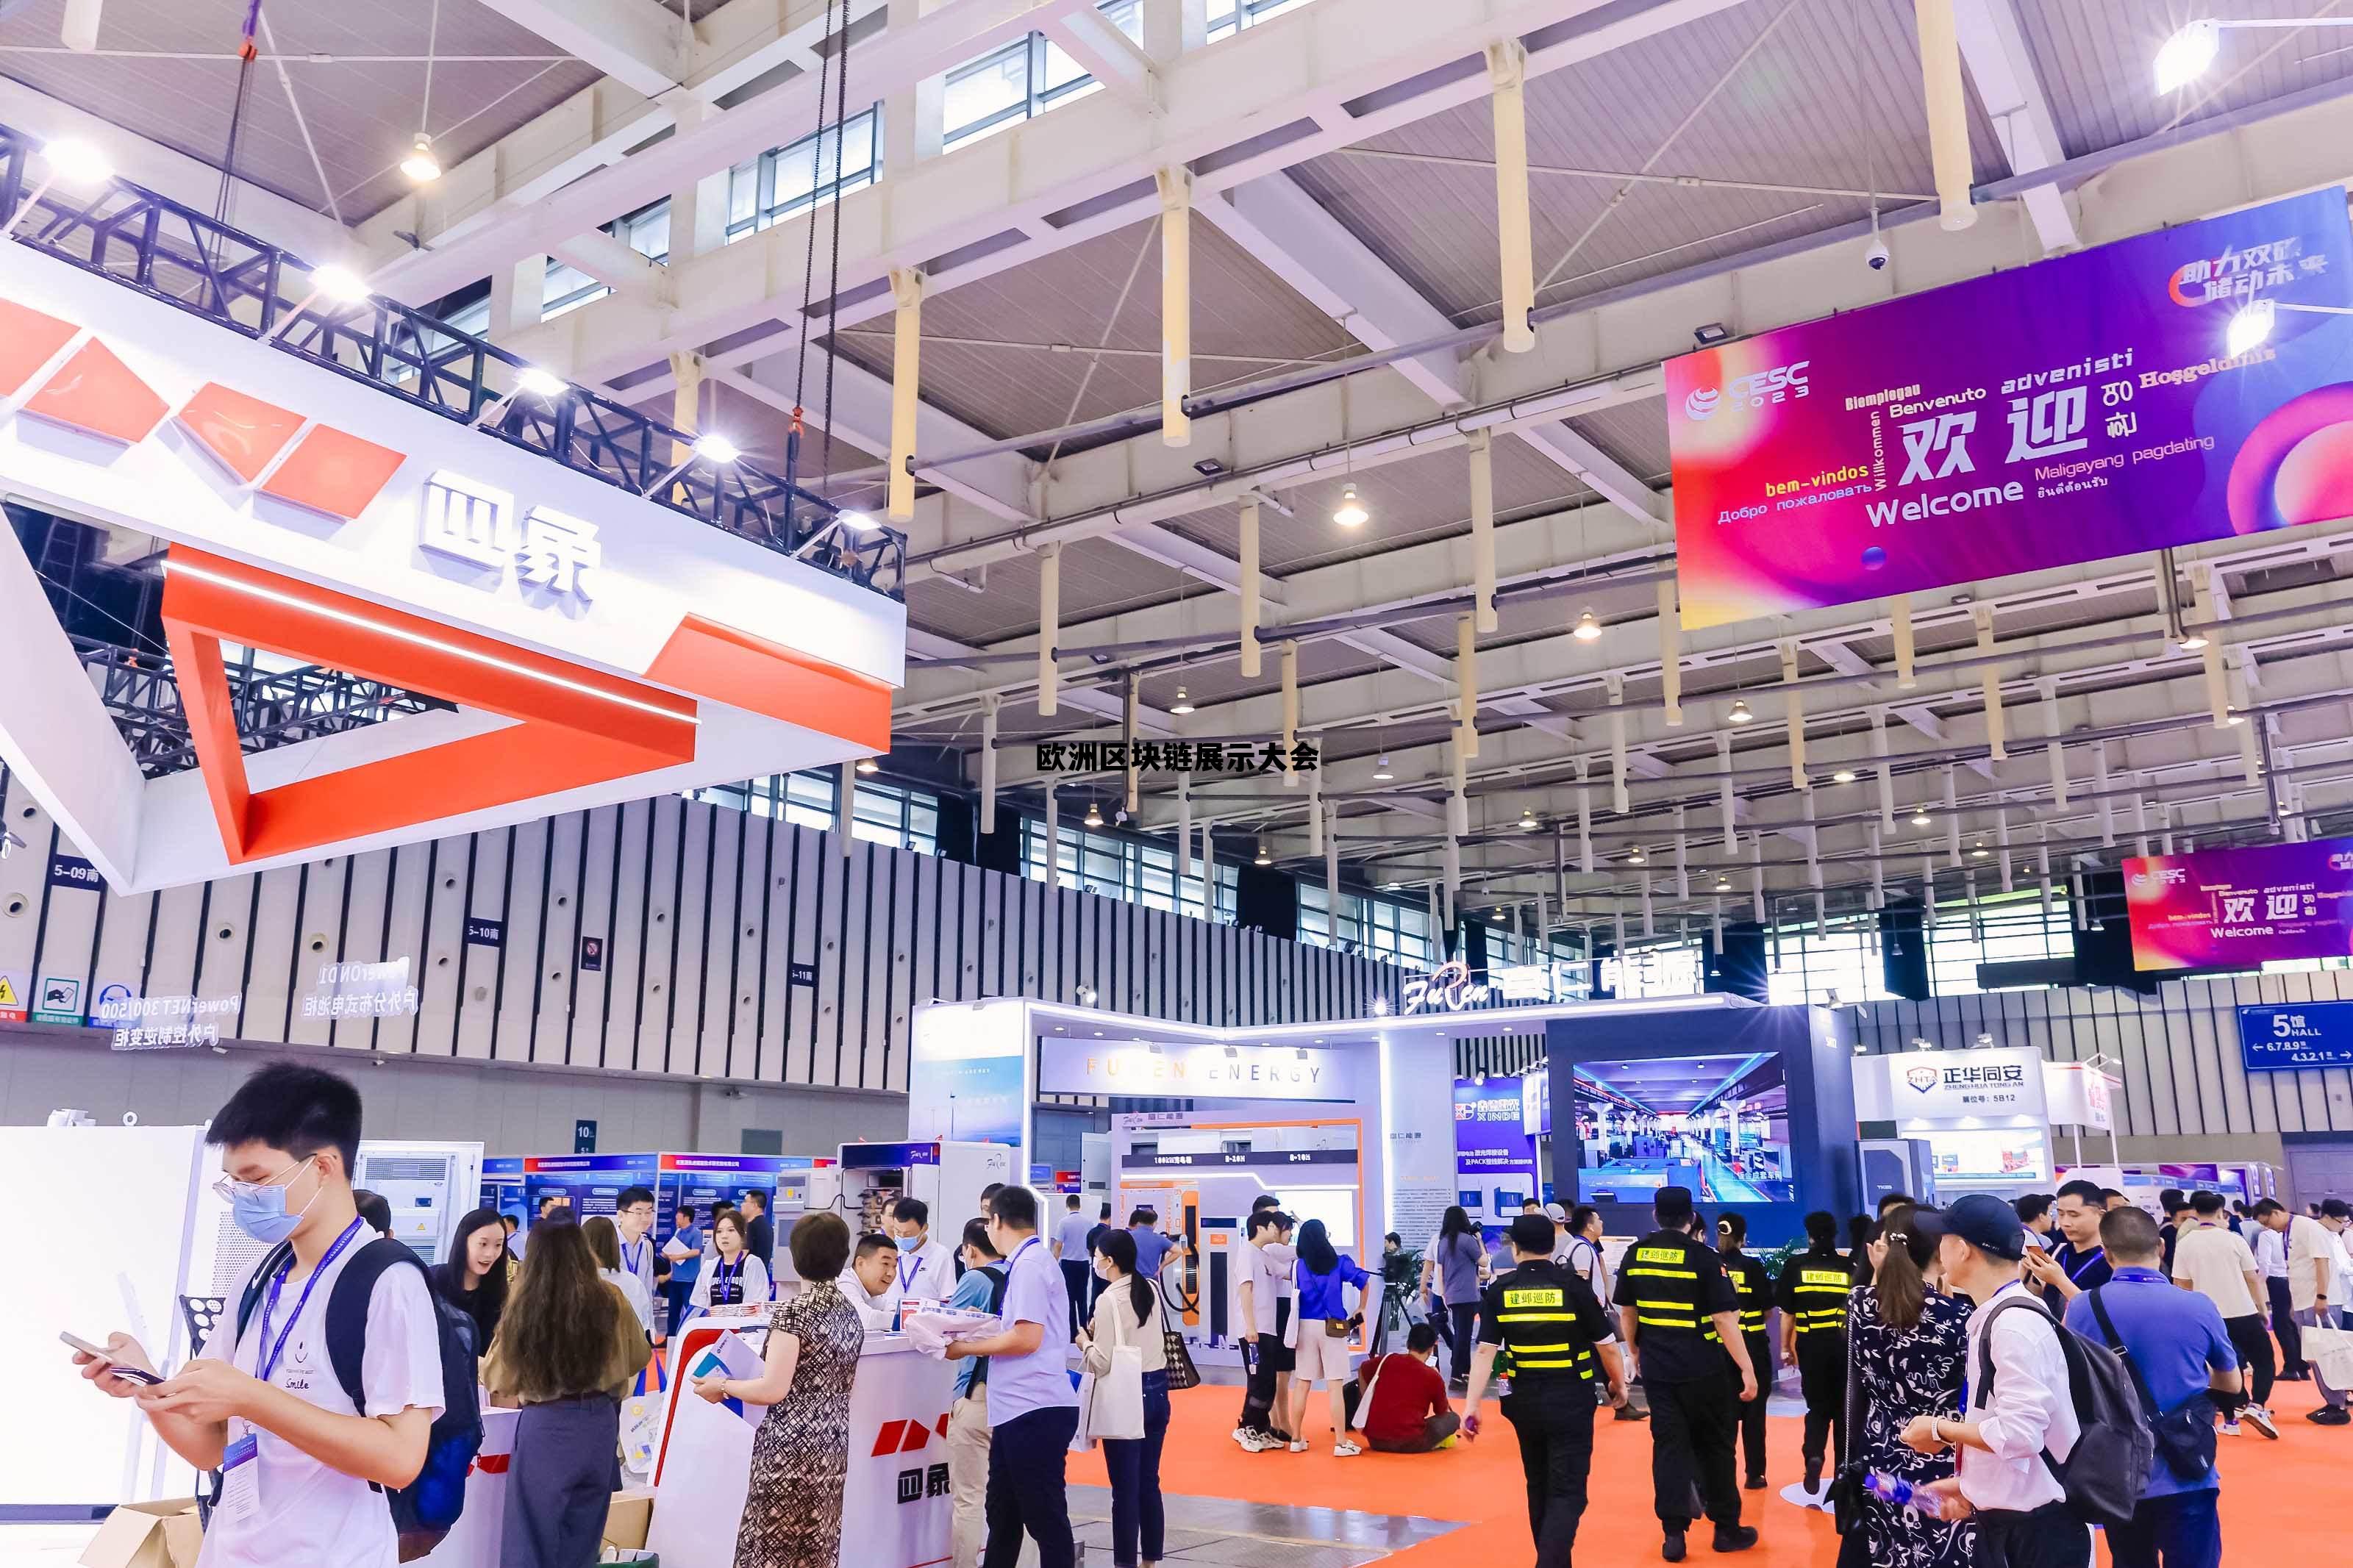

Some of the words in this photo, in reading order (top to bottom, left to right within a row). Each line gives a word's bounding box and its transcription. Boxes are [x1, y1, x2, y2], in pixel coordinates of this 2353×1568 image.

[1729, 360, 1810, 399] CESC
[2001, 347, 2133, 394] advenisti
[1889, 387, 1986, 418] Benvenuto
[1870, 411, 1888, 492] Willkommen
[1896, 385, 2088, 487] 欢迎
[2035, 453, 2124, 481] Maligayang
[2132, 435, 2215, 465] pagdating
[1765, 465, 1869, 497] bem-vindos
[1717, 504, 1768, 525] Добро
[1777, 483, 1872, 512] пожаловать
[1865, 481, 2024, 528] Welcome
[2223, 894, 2299, 923] 欢迎
[2210, 926, 2274, 939] Welcome
[2291, 1028, 2322, 1037] HALL
[1087, 1057, 1186, 1078] FUEN
[1943, 1065, 2024, 1084] 正华同安
[1993, 1094, 2015, 1102] 5B12
[577, 1126, 589, 1138] 10
[1477, 1111, 1520, 1122] XINDE
[285, 1378, 310, 1389] Smile
[897, 1462, 951, 1505] 四象
